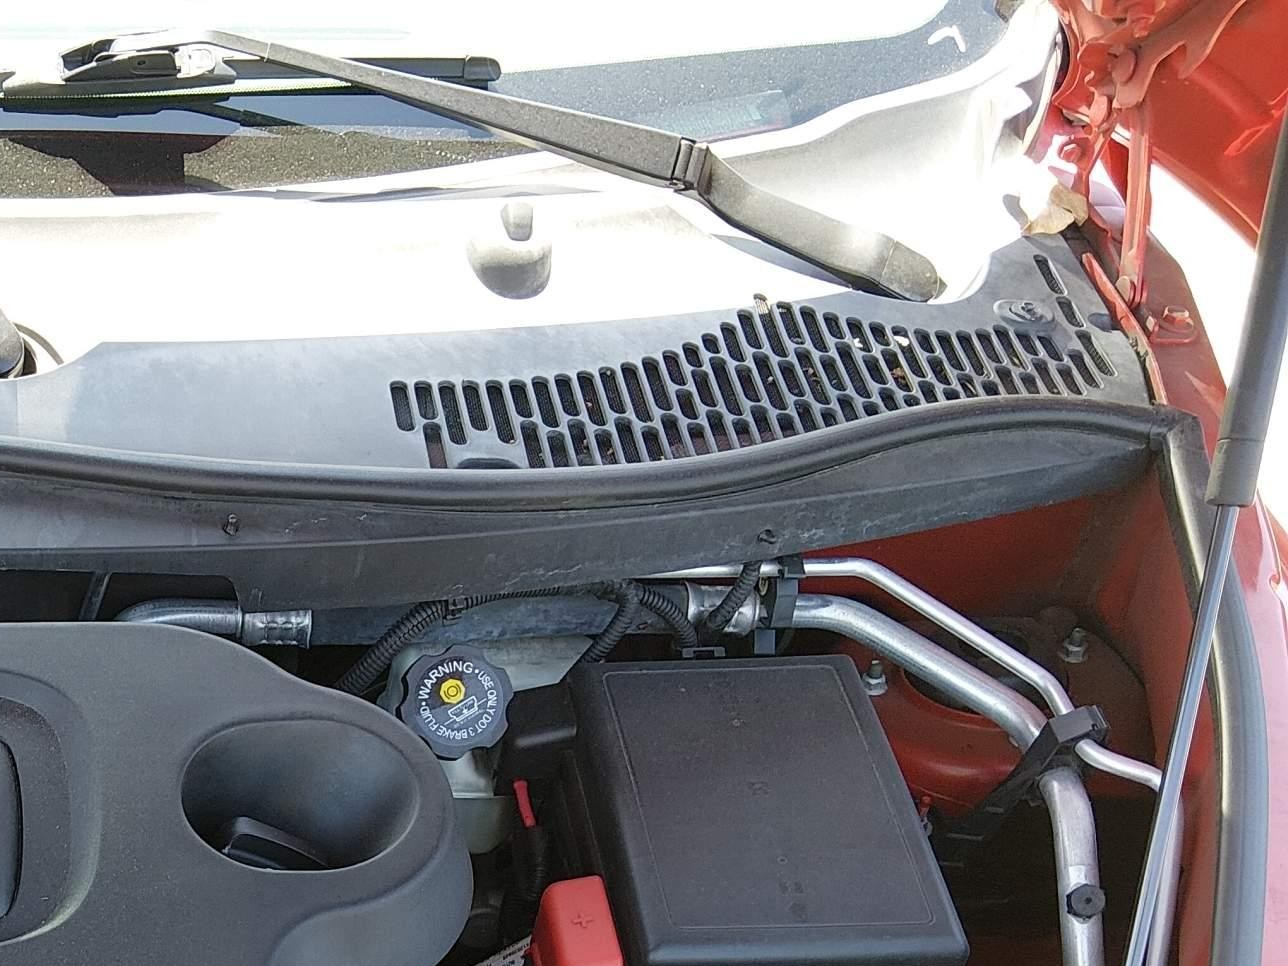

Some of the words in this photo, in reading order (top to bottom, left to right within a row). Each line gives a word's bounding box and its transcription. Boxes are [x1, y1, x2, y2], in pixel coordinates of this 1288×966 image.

[418, 661, 473, 700] WARNING
[477, 671, 494, 691] USE
[487, 690, 497, 716] ONLY
[420, 706, 437, 731] FLUID
[476, 714, 492, 734] DOT
[437, 725, 468, 740] BRAKE
[468, 727, 476, 737] 3
